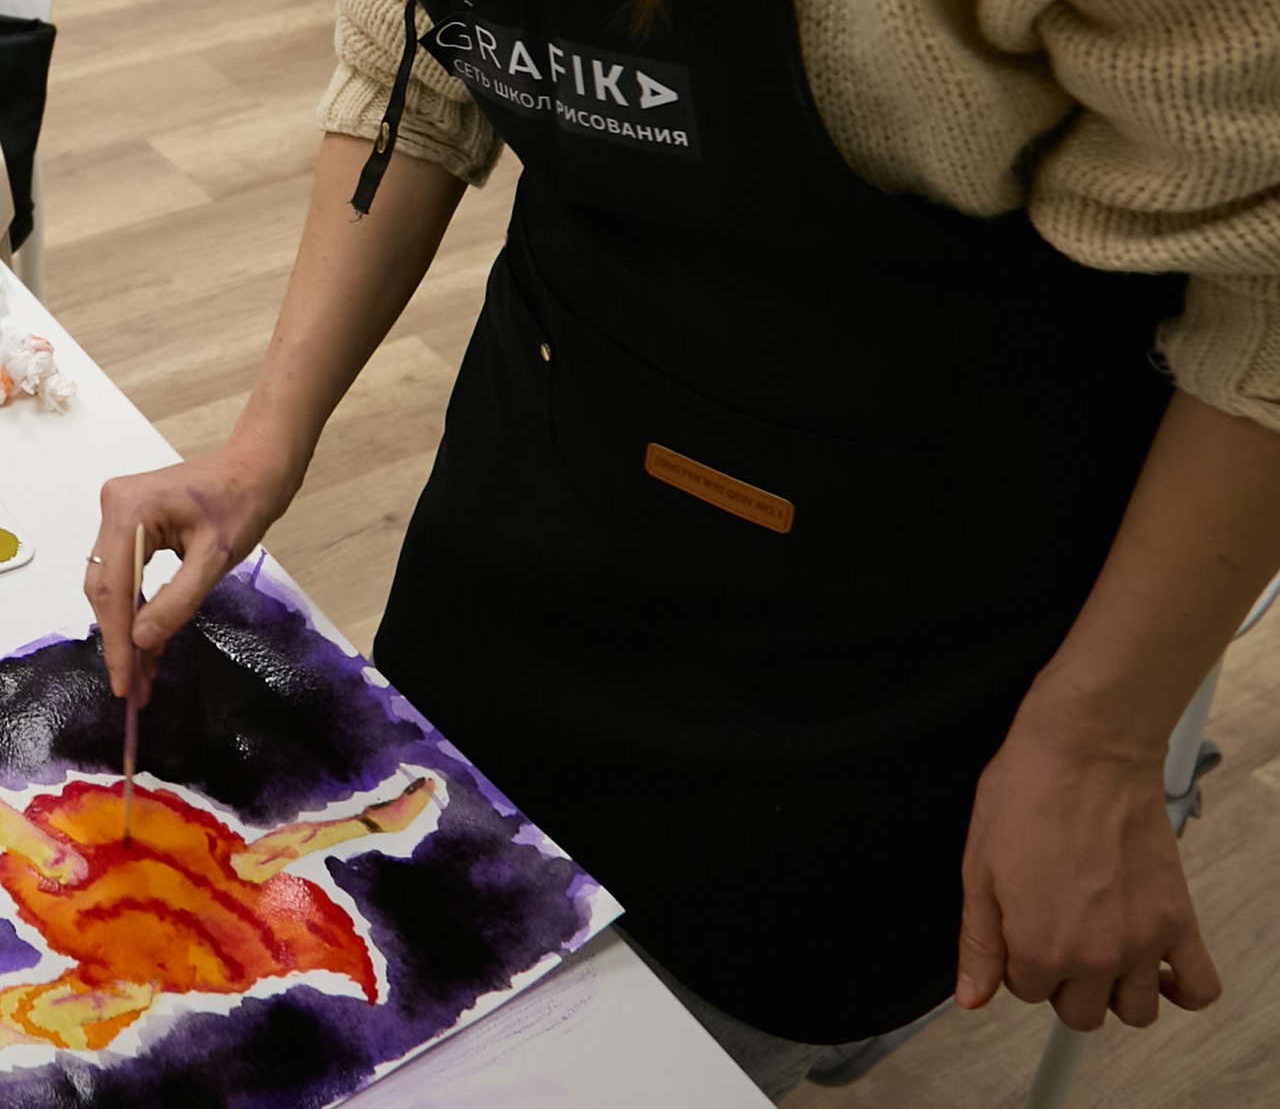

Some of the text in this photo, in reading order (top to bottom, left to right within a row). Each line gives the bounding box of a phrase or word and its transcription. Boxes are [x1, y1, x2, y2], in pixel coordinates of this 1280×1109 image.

[435, 21, 679, 110] GRAFIKA
[453, 58, 689, 147] СЕТЬ ШКОЛ РИСОВАНИЯ
